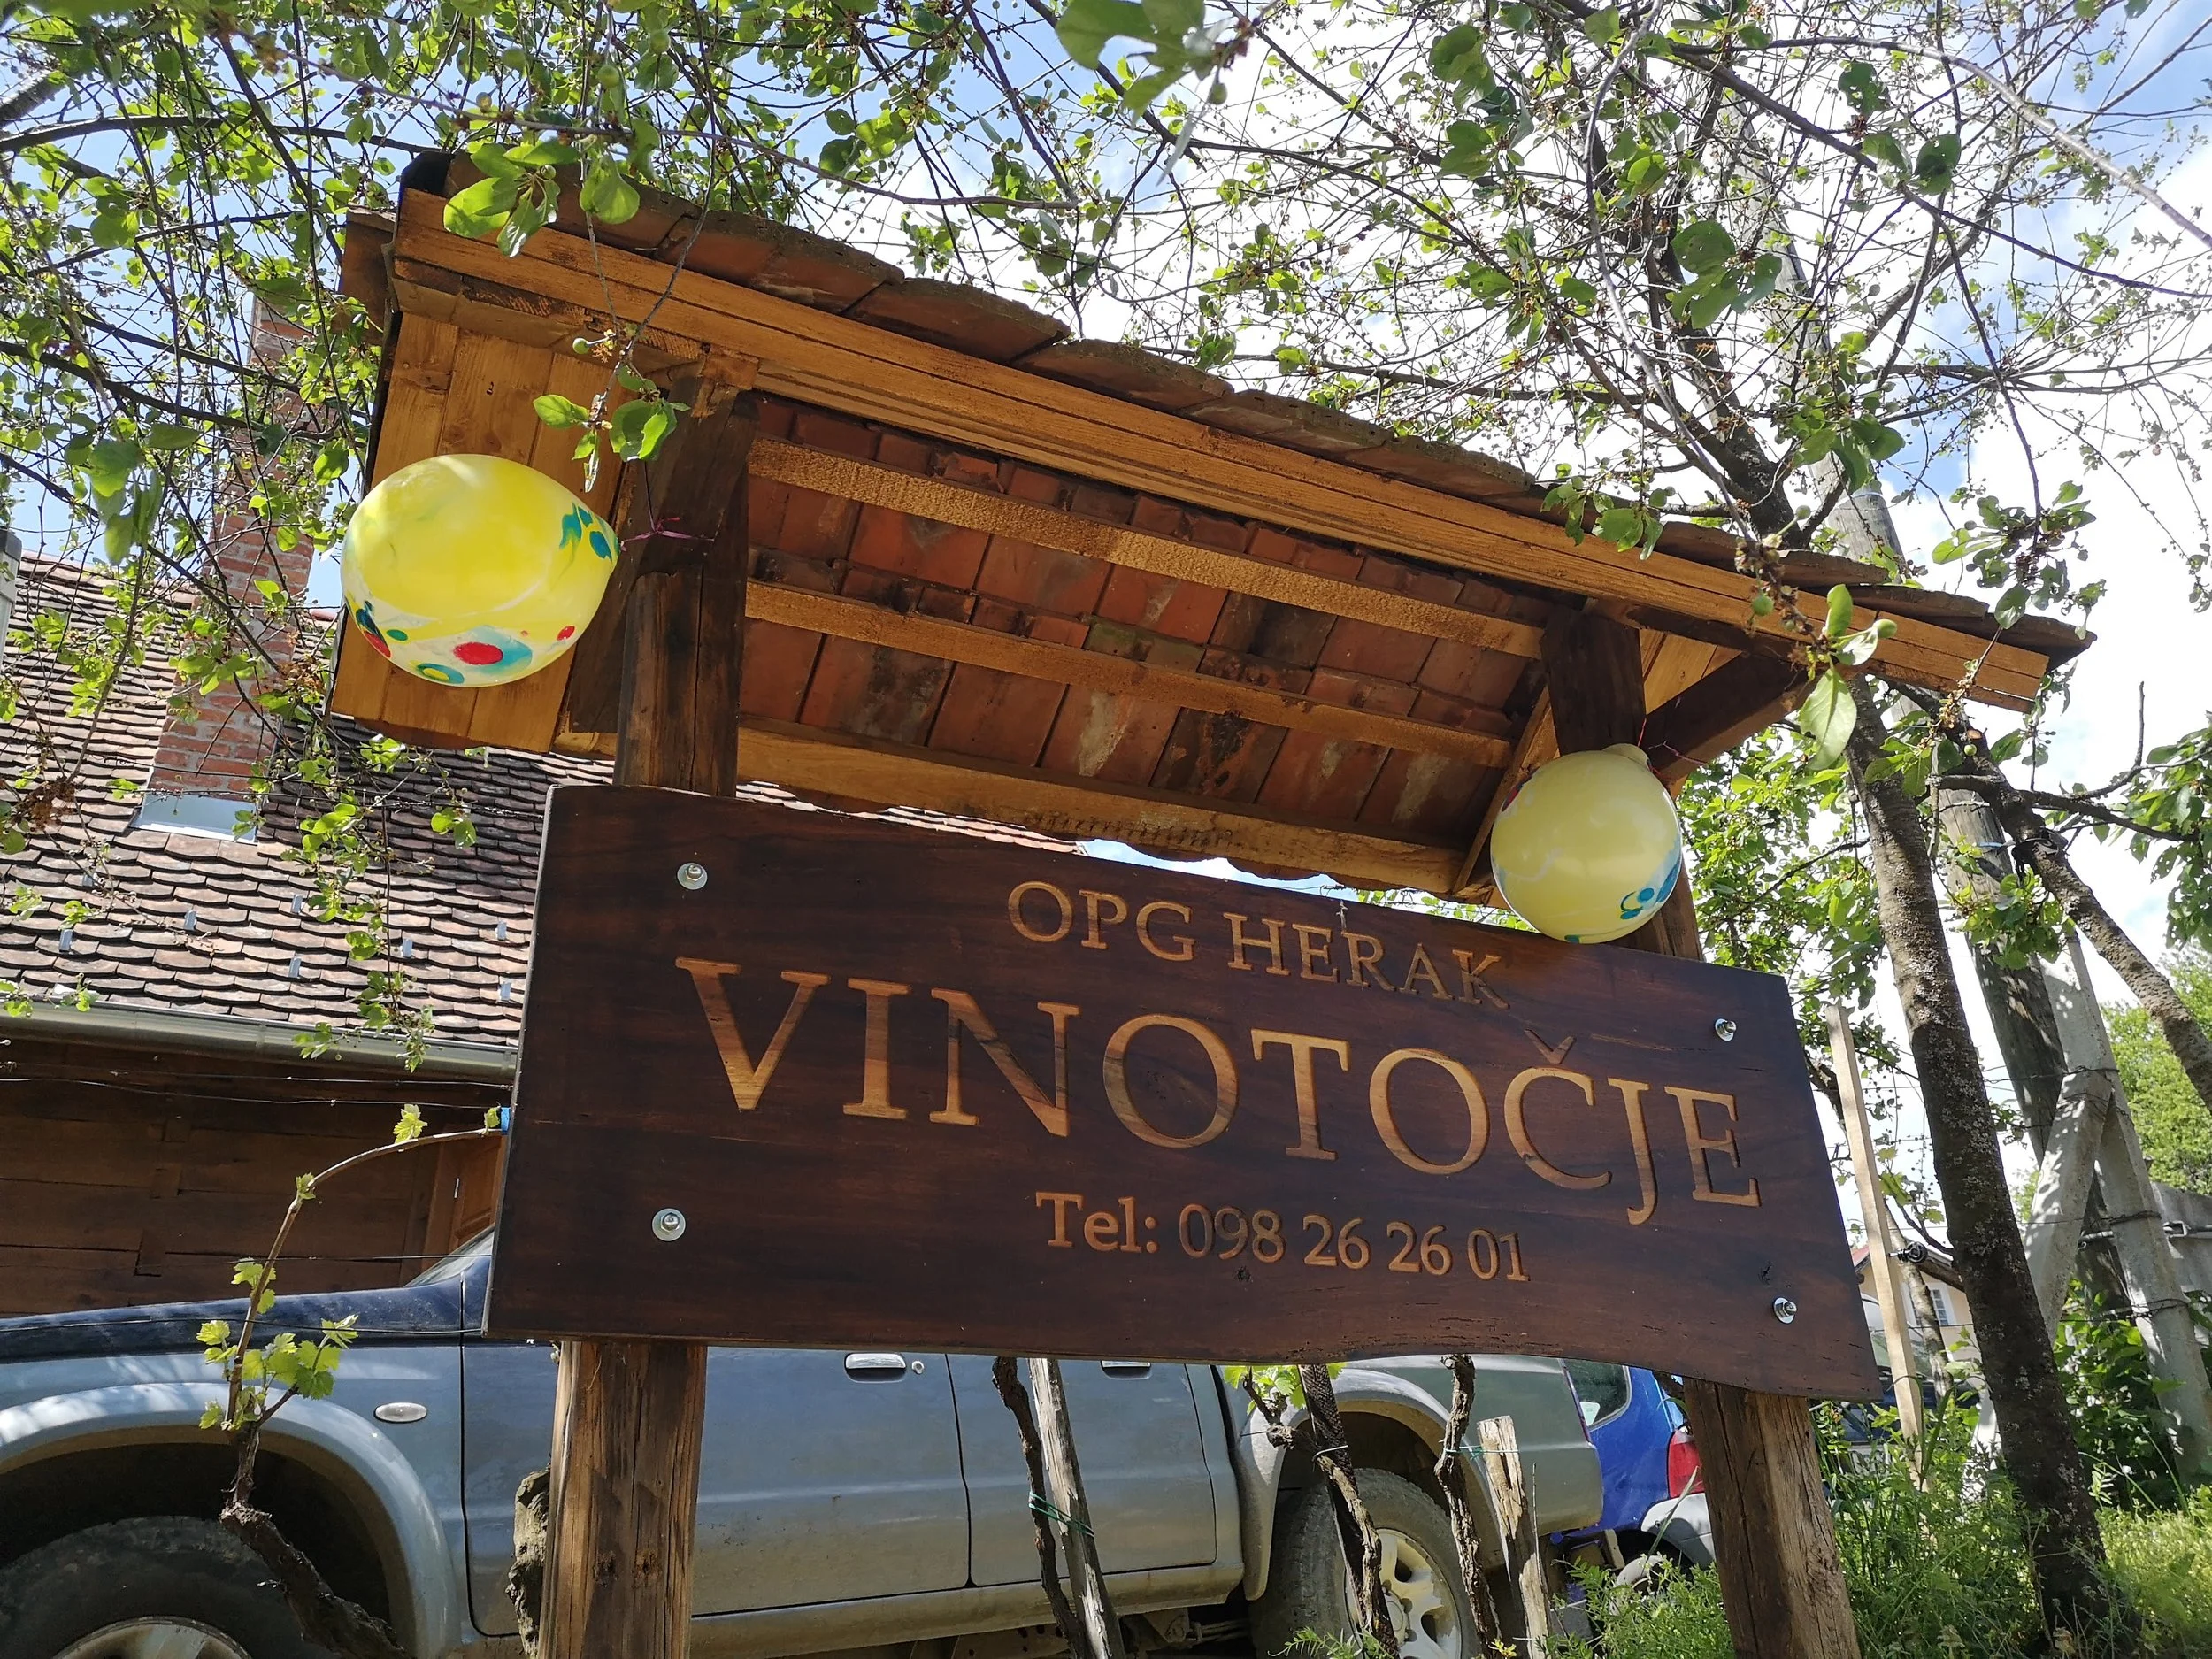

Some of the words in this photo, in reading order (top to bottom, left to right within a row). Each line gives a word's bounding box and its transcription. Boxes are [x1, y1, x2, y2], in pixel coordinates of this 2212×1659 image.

[1008, 880, 1197, 962] OPG
[1223, 911, 1510, 1010] HERAK
[674, 956, 1762, 1226] VINOTOČJE
[1035, 1191, 1159, 1254] Tel:
[1178, 1202, 1286, 1263] 098
[1302, 1213, 1371, 1271] 26
[1386, 1220, 1453, 1276] 26
[1466, 1227, 1531, 1282] 01
